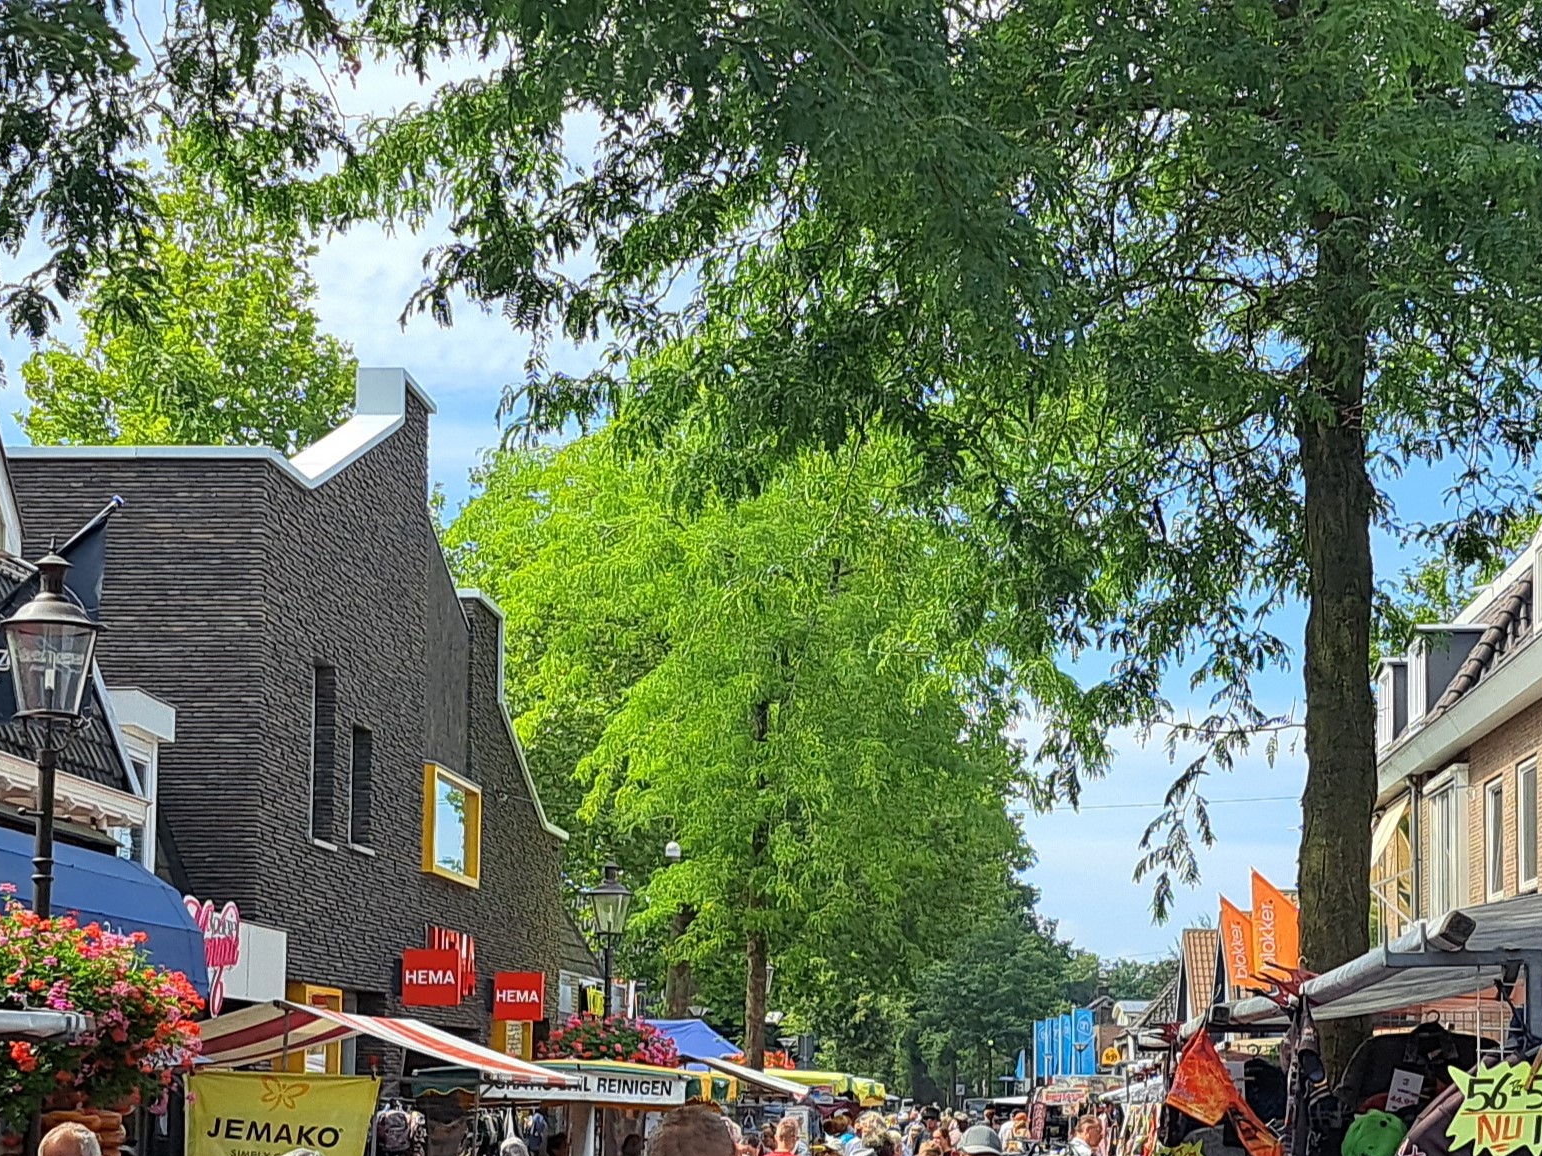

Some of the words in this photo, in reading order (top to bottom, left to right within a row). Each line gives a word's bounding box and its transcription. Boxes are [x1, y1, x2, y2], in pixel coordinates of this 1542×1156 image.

[405, 969, 455, 985] HEMA
[496, 989, 539, 1003] HEMA
[596, 1077, 673, 1096] REINIGEN
[207, 1117, 340, 1148] JEMAKO
[1477, 1115, 1523, 1145] NU
